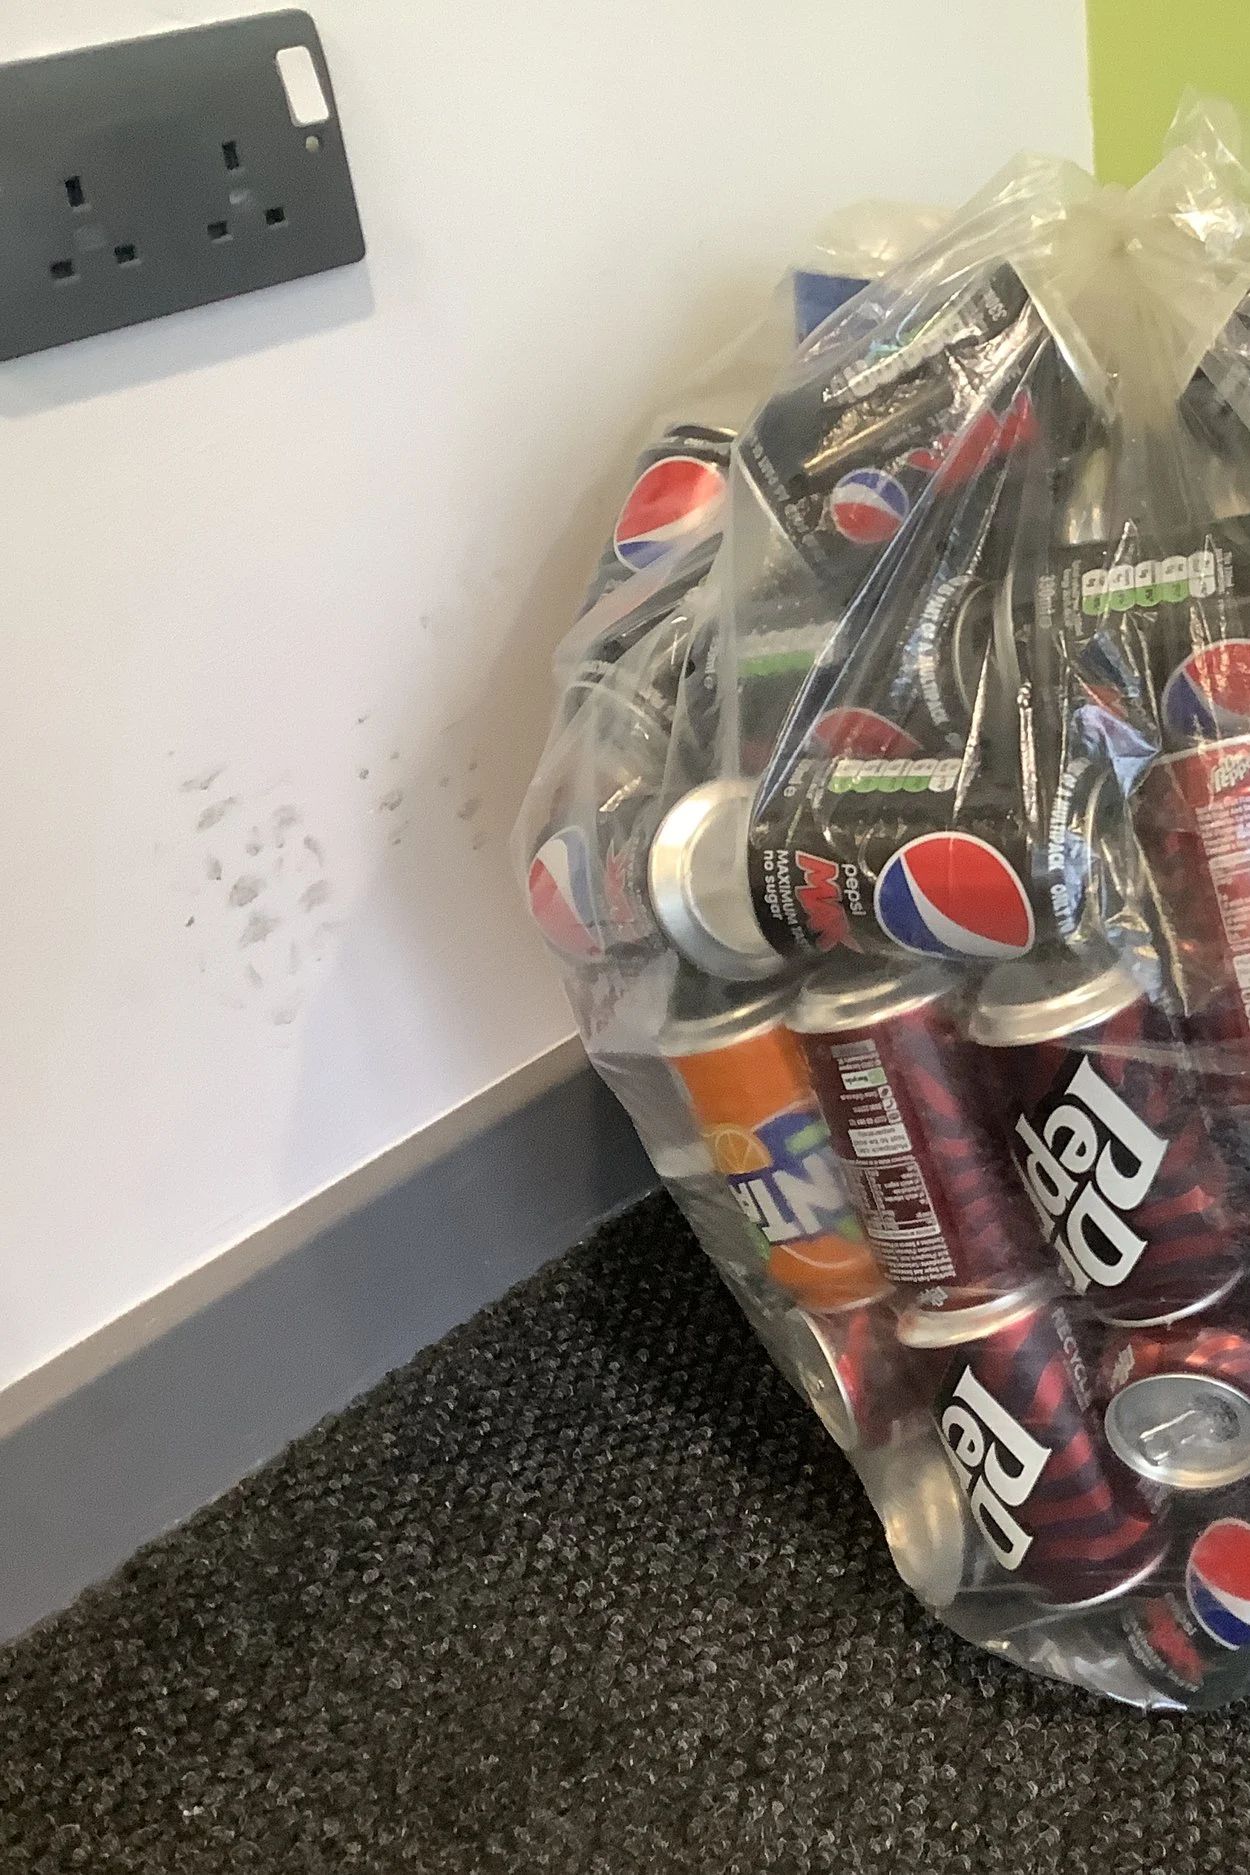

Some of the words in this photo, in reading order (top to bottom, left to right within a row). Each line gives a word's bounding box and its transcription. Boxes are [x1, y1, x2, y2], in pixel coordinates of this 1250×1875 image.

[764, 850, 775, 871] no
[764, 877, 784, 921] sugar
[775, 849, 799, 925] MAXIMUM
[842, 863, 867, 916] pepsi
[1050, 884, 1072, 917] ONLY
